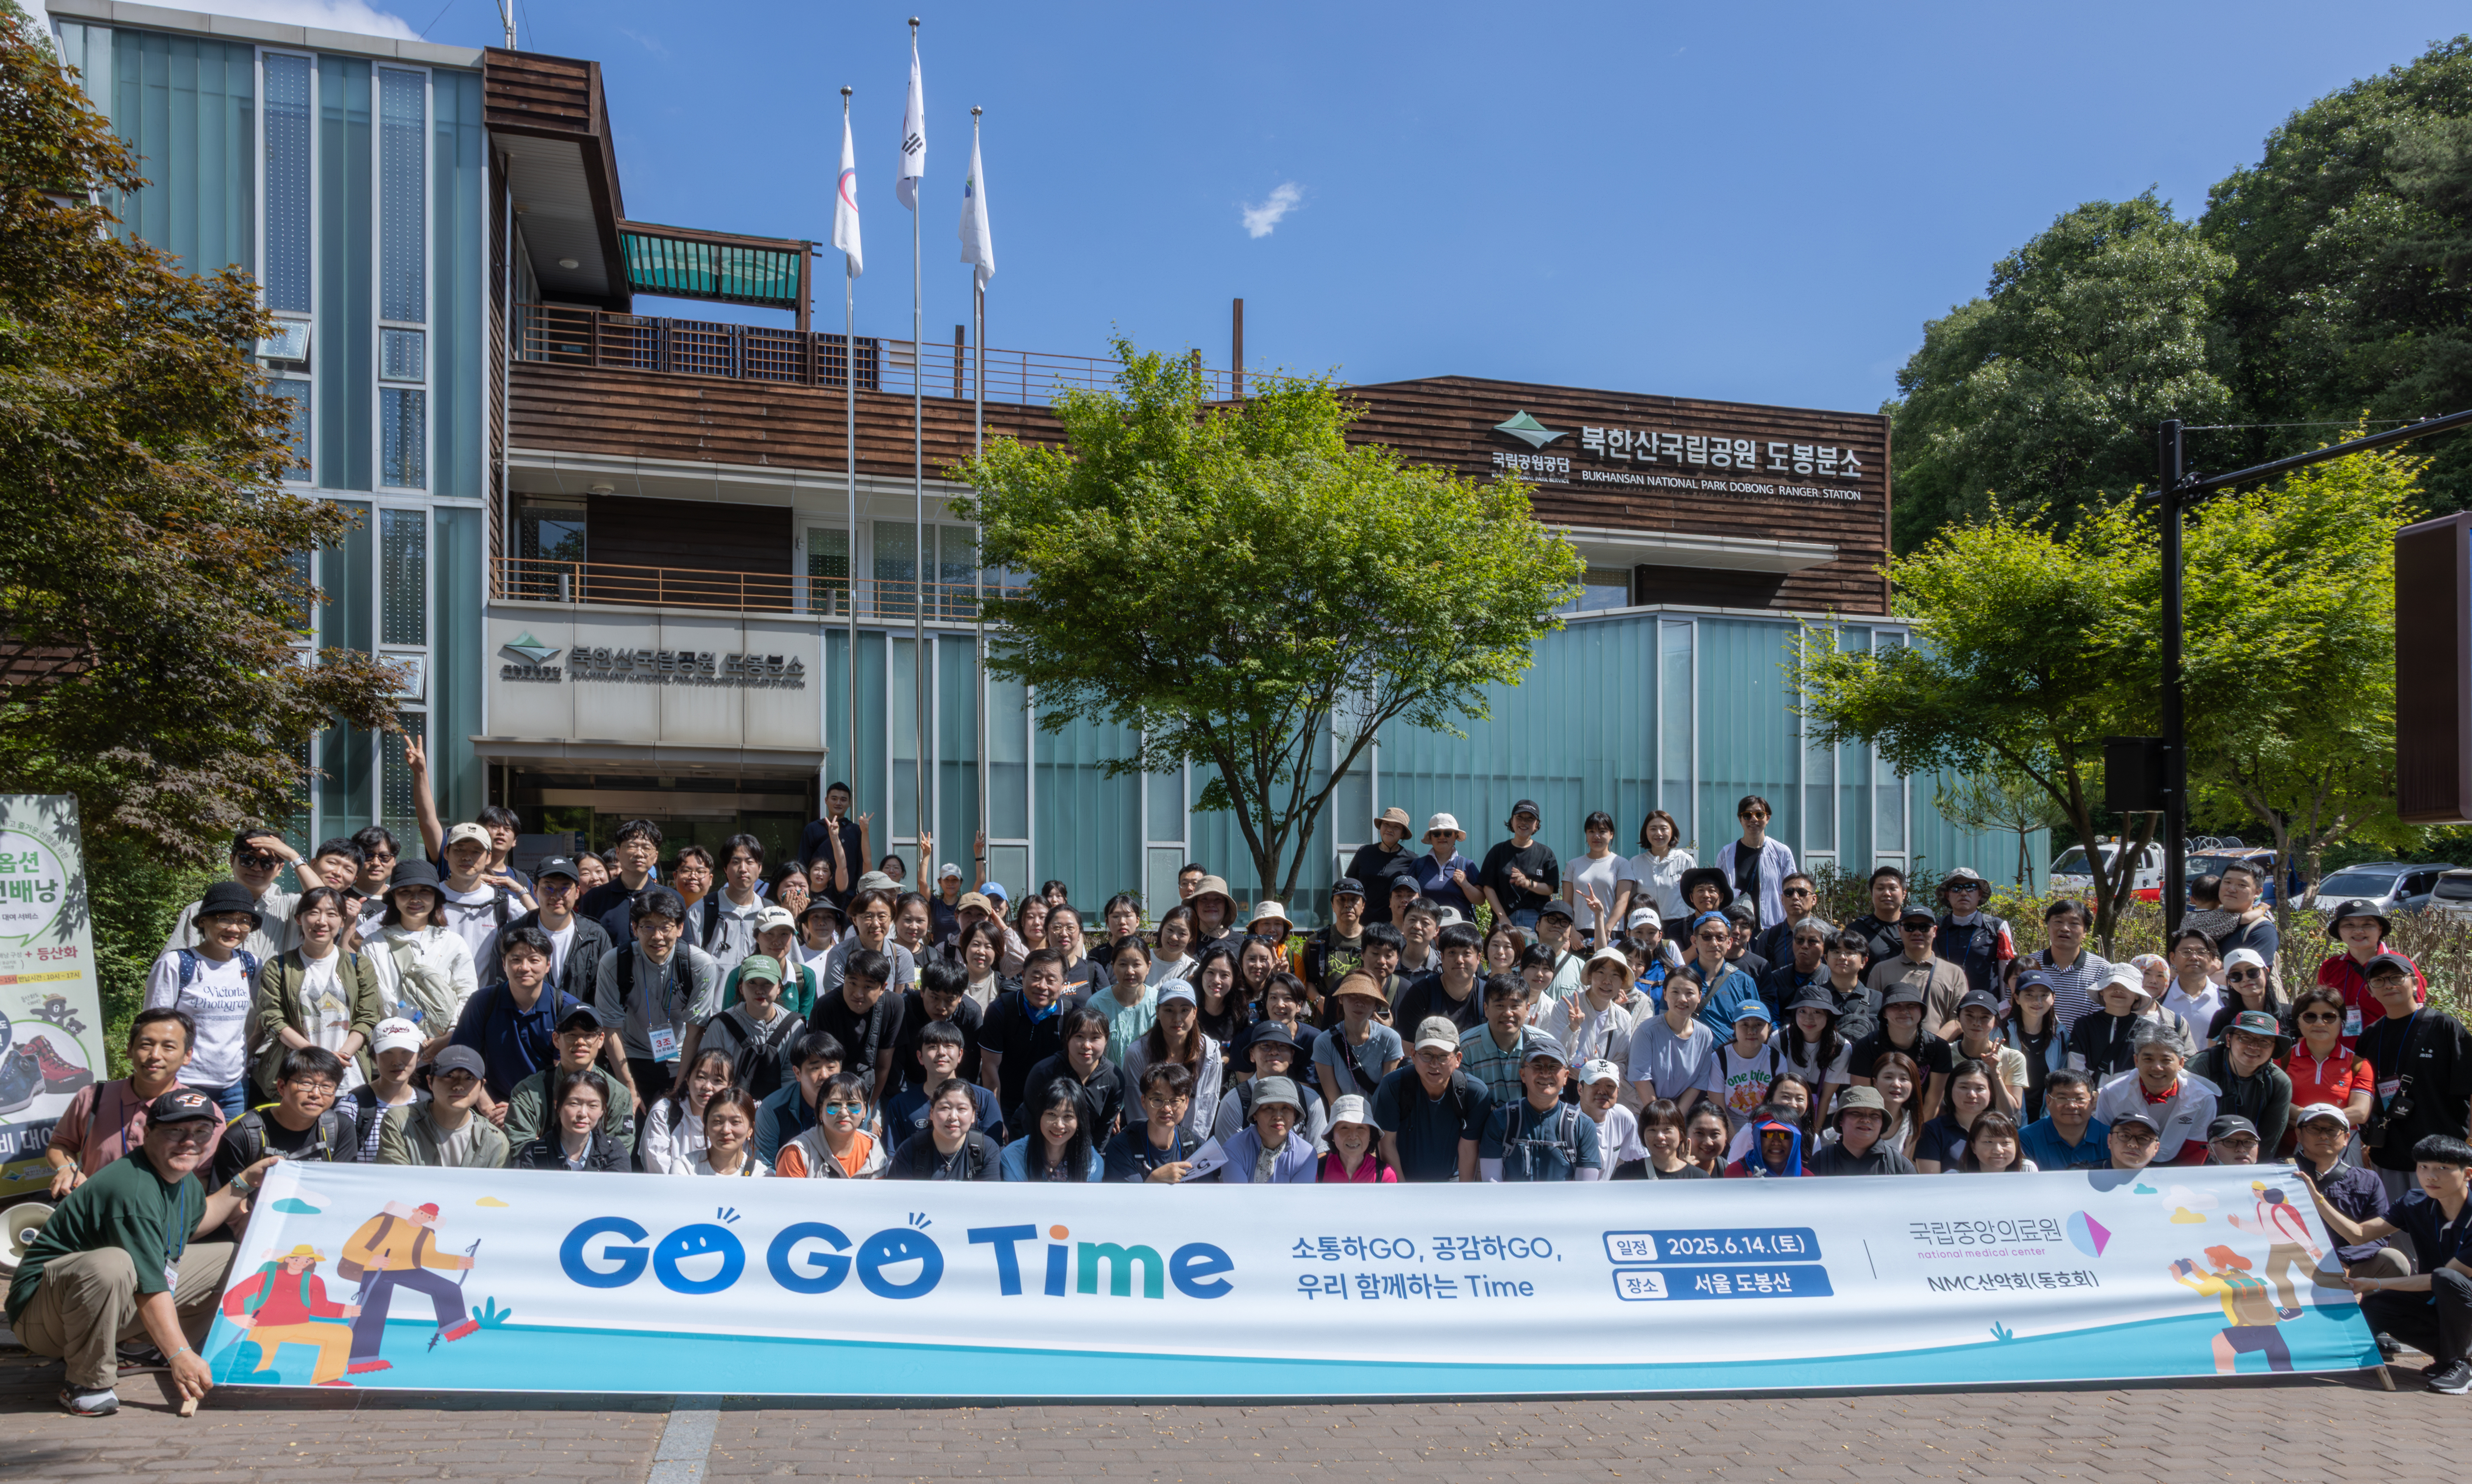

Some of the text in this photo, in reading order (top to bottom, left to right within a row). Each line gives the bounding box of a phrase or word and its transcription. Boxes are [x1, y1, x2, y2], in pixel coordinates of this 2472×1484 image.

[1582, 426, 1862, 478] 북한산국립공원 도봉분소
[1492, 452, 1570, 473] 국립공원공단
[1582, 470, 1861, 501] BUKHANSAN NATIONAL PARK DOBONG RANGER STATION
[573, 646, 805, 675] 북한산국립공원 도봉분소
[572, 672, 626, 681] BUKHANSAN
[37, 946, 78, 961] 등산화
[204, 986, 247, 997] Victoria
[1060, 981, 1077, 993] ike
[656, 1037, 672, 1047] 3조
[1727, 1070, 1771, 1086] one bite
[1910, 1218, 2062, 1245] 국립중앙의료원
[1292, 1236, 1561, 1263] 소통하GO, 공감하GO,
[1617, 1240, 1648, 1256] 일정
[1667, 1235, 1805, 1255] 2025.6.14.(토)
[1918, 1247, 2046, 1259] national medical center
[559, 1216, 1234, 1300] GO GO Time
[1297, 1273, 1534, 1300] 우리 함께하는 Time
[1626, 1278, 1659, 1294] 장소
[1695, 1273, 1793, 1294] 서울 도봉산
[1927, 1271, 2100, 1292] NMC산악회(동호회)
